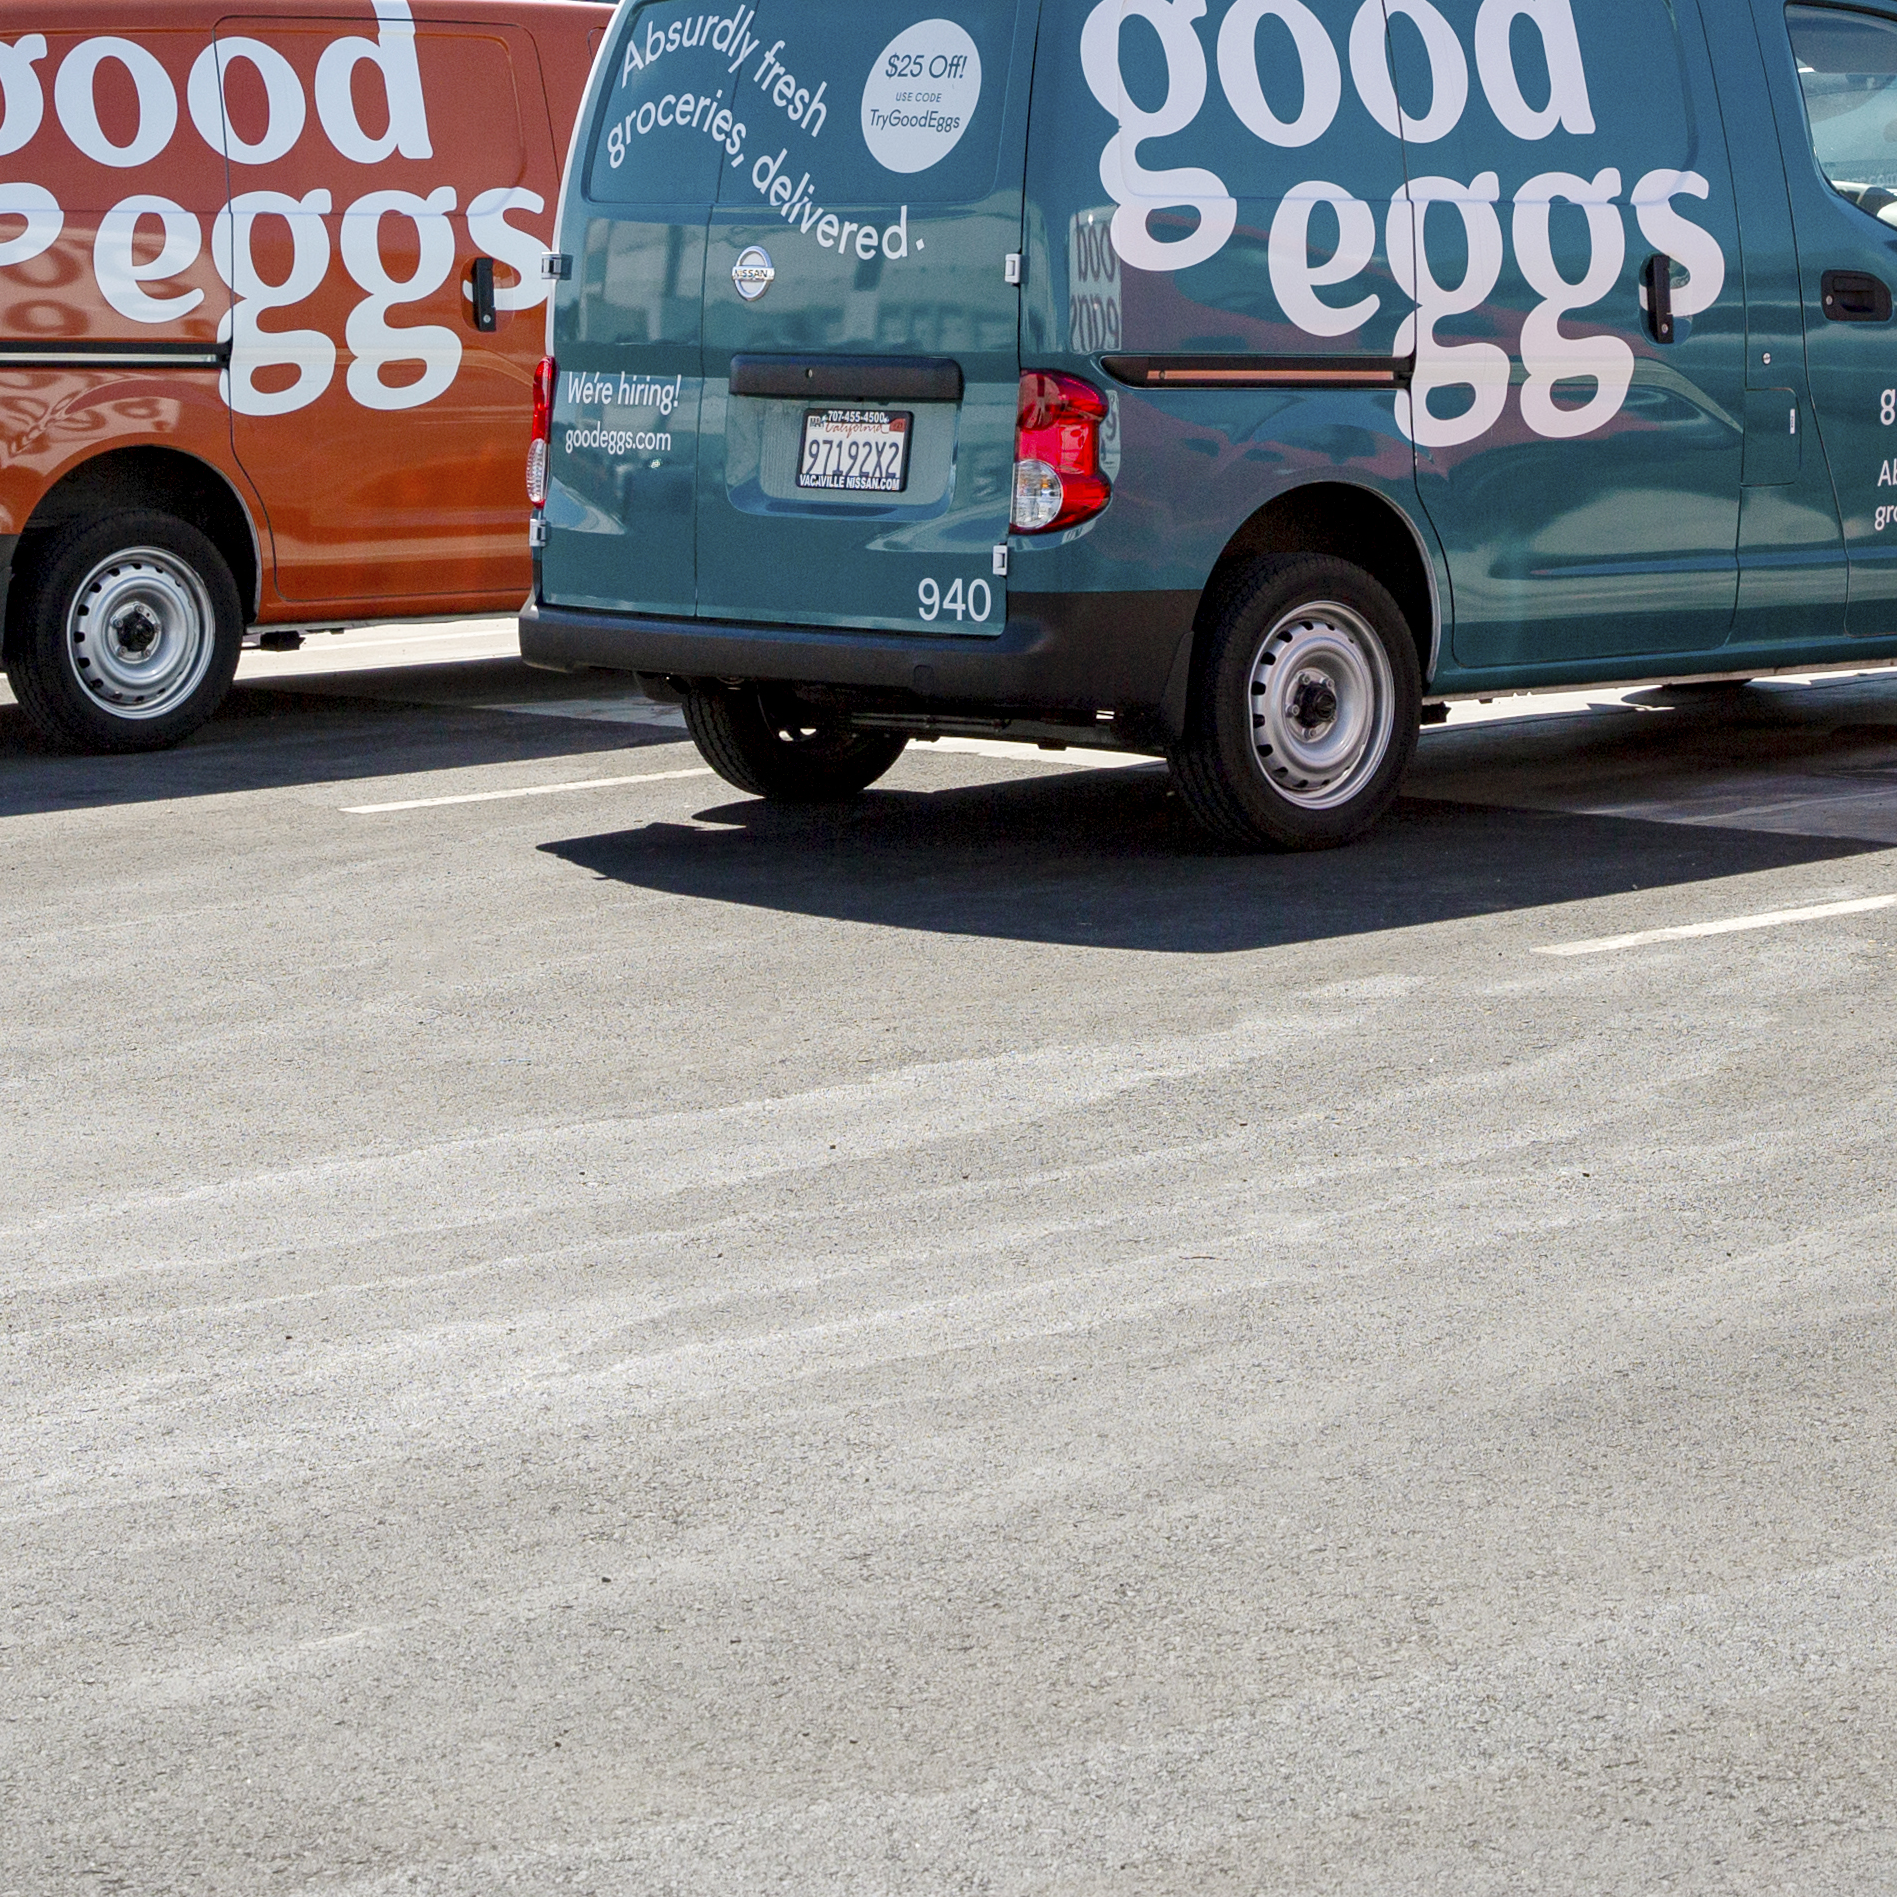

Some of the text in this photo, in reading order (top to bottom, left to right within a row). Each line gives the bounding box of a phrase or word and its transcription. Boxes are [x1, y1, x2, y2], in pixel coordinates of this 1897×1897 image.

[621, 4, 828, 137] Absurdly fresh
[885, 53, 967, 80] $25 Off!
[895, 91, 942, 103] USE CODE
[870, 109, 960, 133] TryGoodEggs
[607, 89, 925, 260] groceries, delivered.
[733, 269, 769, 279] NISSAN
[93, 186, 552, 416] eggs
[1268, 168, 1725, 447] eggs
[617, 374, 681, 415] hiring!
[828, 410, 885, 423] 707-455-4500
[565, 421, 672, 454] goodeggs.com
[806, 439, 899, 478] 97192X2
[846, 476, 900, 490] NISSAN.COM
[917, 578, 992, 622] 940
